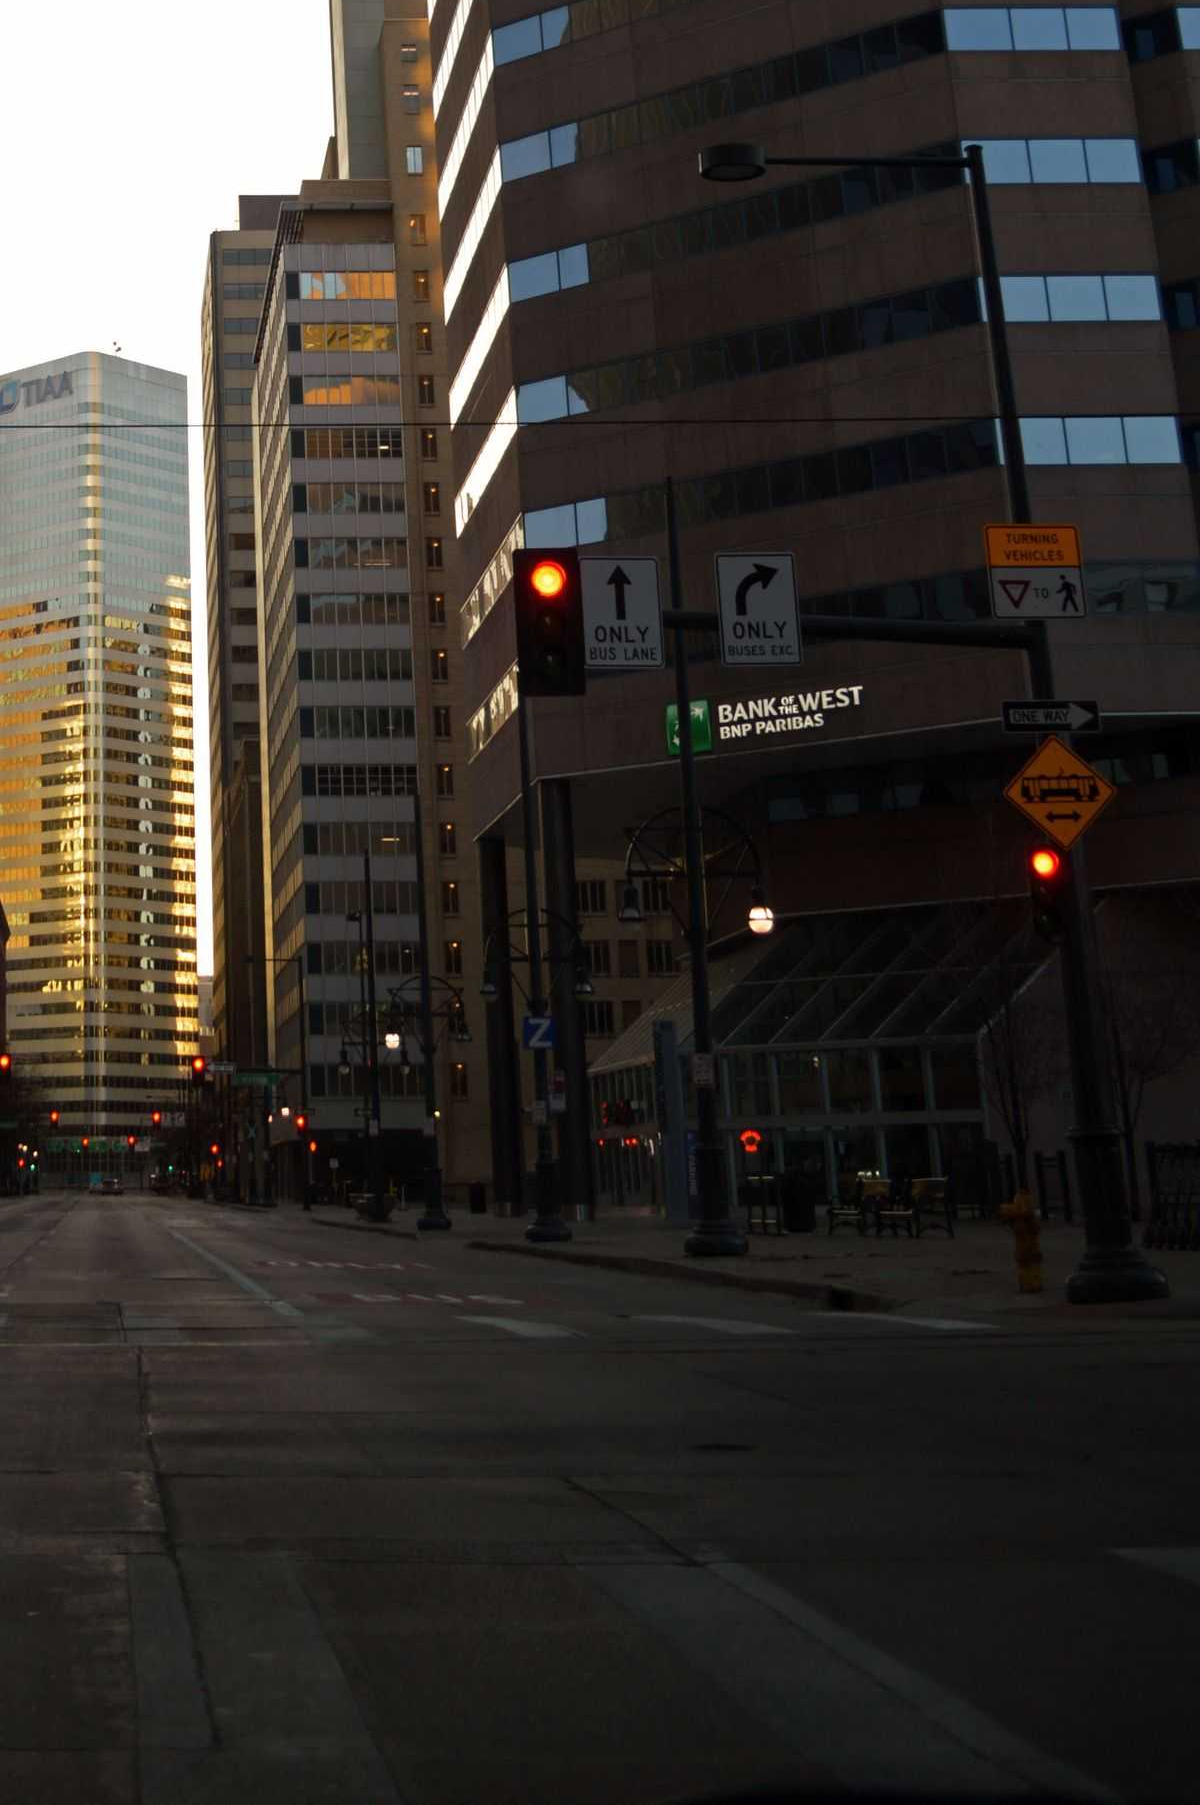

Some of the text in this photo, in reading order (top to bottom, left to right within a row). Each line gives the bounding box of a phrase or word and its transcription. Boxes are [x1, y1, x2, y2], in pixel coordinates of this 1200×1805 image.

[21, 371, 74, 406] TIAA
[1005, 533, 1059, 544] TURNING
[1003, 549, 1065, 562] VEHICLES
[1033, 587, 1049, 599] TO
[595, 625, 649, 643] ONLY
[733, 621, 787, 639] ONLY
[590, 647, 657, 661] BUS LANE
[728, 645, 765, 656] BUSES
[718, 685, 864, 723] BANK OF THE WEST
[1013, 709, 1068, 722] ONE WAY
[720, 713, 824, 740] BNP PARIBAS
[528, 1018, 552, 1047] Z
